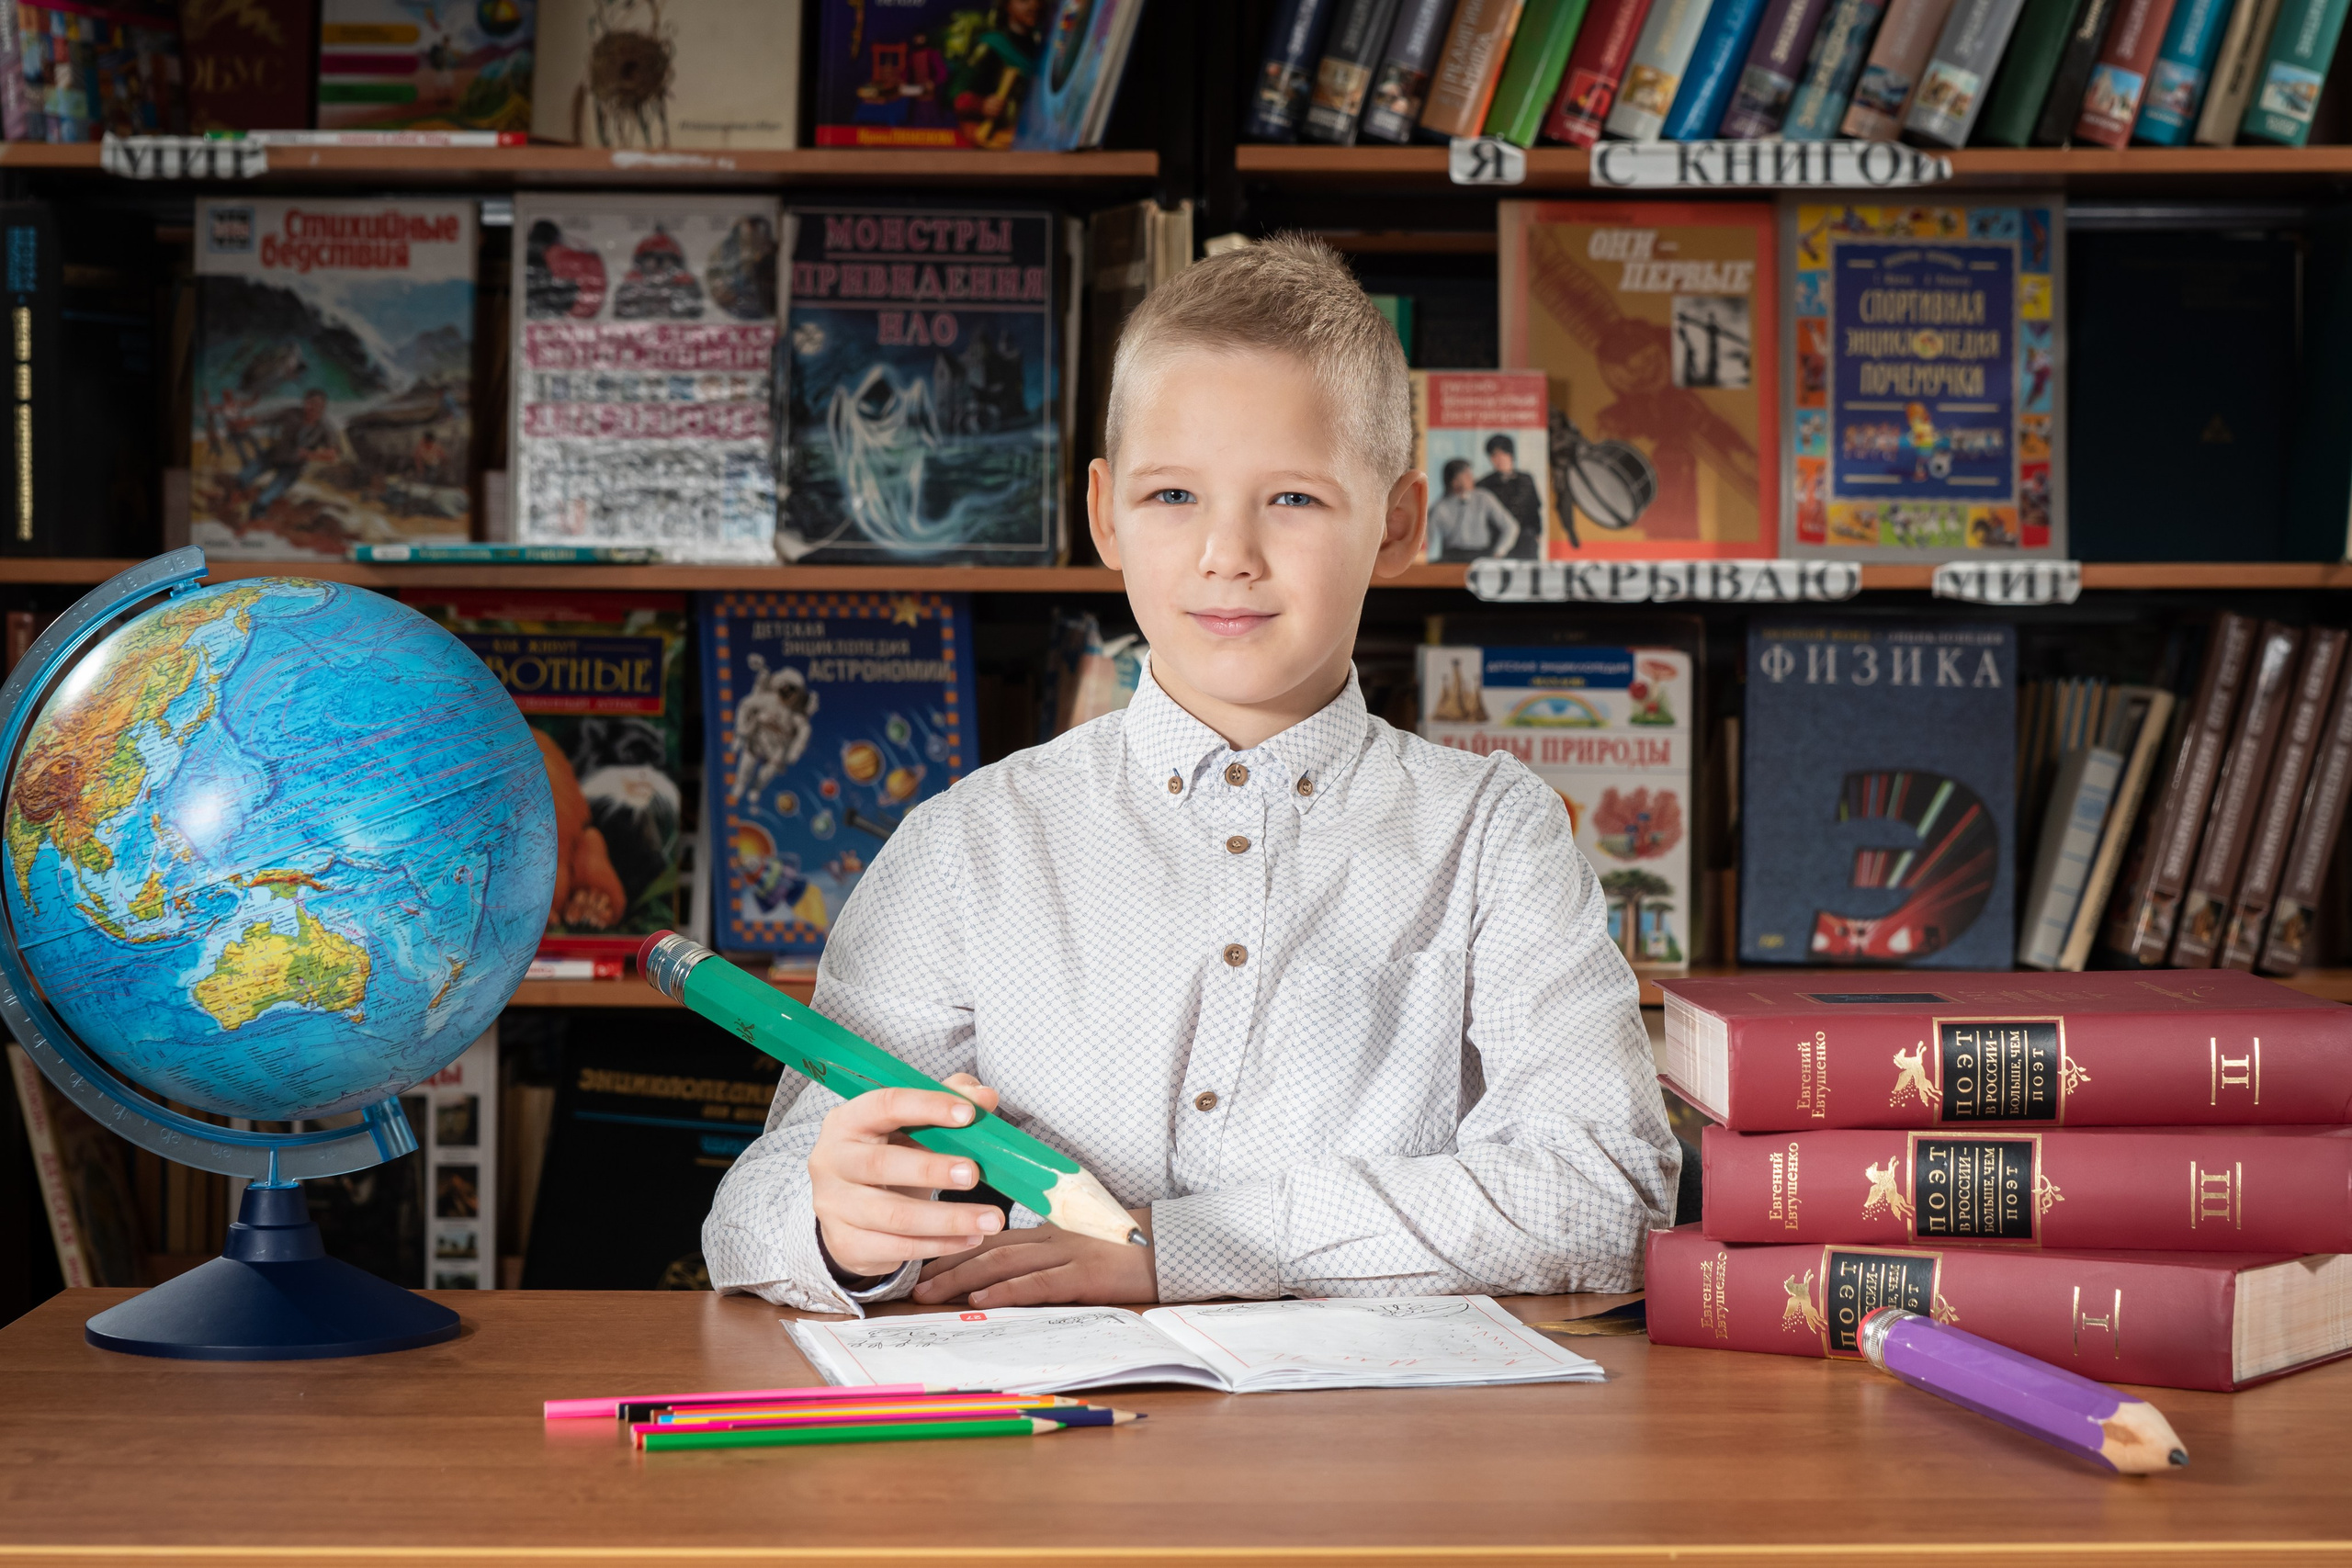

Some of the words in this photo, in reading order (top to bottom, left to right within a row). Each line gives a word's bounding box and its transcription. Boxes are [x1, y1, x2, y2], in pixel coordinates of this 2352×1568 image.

[1472, 142, 1502, 178] Я
[1597, 142, 1636, 184] С
[285, 209, 458, 242] Стихийные
[825, 217, 1012, 253] МОНСТРЫ
[261, 234, 409, 272] бедствия
[791, 262, 1046, 302] ПРИВИДЕНИЯ
[1619, 260, 1755, 292] ПЕРВЫЕ
[1859, 290, 1985, 324] СПОРТИВНАЯ
[877, 310, 958, 347] НЛО
[1860, 363, 1985, 397] ПОЧЕМУЧКИ
[1473, 563, 1857, 602] ОТКРЫВАЮ
[752, 621, 825, 640] ДЕТСКАЯ
[781, 638, 910, 658] ЭНЦИКЛОПЕДИЯ
[484, 655, 652, 693] ВОТНЫЕ
[808, 659, 951, 683] АСТРОНОМИИ
[1759, 644, 2003, 688] ФИЗИКА
[1541, 737, 1670, 767] ПРИРОДЫ
[2009, 1030, 2021, 1056] ЧЕМ
[1796, 1041, 1811, 1110] Евгений
[1812, 1031, 1831, 1119] Евтушенко
[1956, 1031, 1974, 1115] ПОЭТ
[1984, 1030, 1997, 1102] РОССИИ-
[2032, 1047, 2044, 1102] ПОЭТ
[2221, 1054, 2250, 1089] II
[577, 1067, 776, 1107] ЭНЦИКЛОПЕДИ
[2009, 1058, 2022, 1115] БОЛЬШЕ,
[1984, 1104, 1996, 1115] В
[1984, 1147, 1996, 1174] ЧЕМ
[1769, 1152, 1783, 1221] Евгений
[1784, 1142, 1803, 1231] Евтушенко
[1928, 1146, 1948, 1232] ПОЭТ
[1959, 1146, 1971, 1220] РОССИИ-
[2007, 1166, 2018, 1220] ПОЭТ
[2200, 1169, 2231, 1222] III
[1984, 1176, 1996, 1233] БОЛЬШЕ,
[1959, 1222, 1970, 1233] В
[1701, 1259, 1714, 1329] Евгений
[1715, 1251, 1729, 1340] Евтушенко
[1864, 1262, 1878, 1314] ССИИ-
[1889, 1264, 1900, 1292] ЧЕМ
[1907, 1283, 1920, 1308] ЭТ
[1839, 1261, 1858, 1348] ПОЭТ
